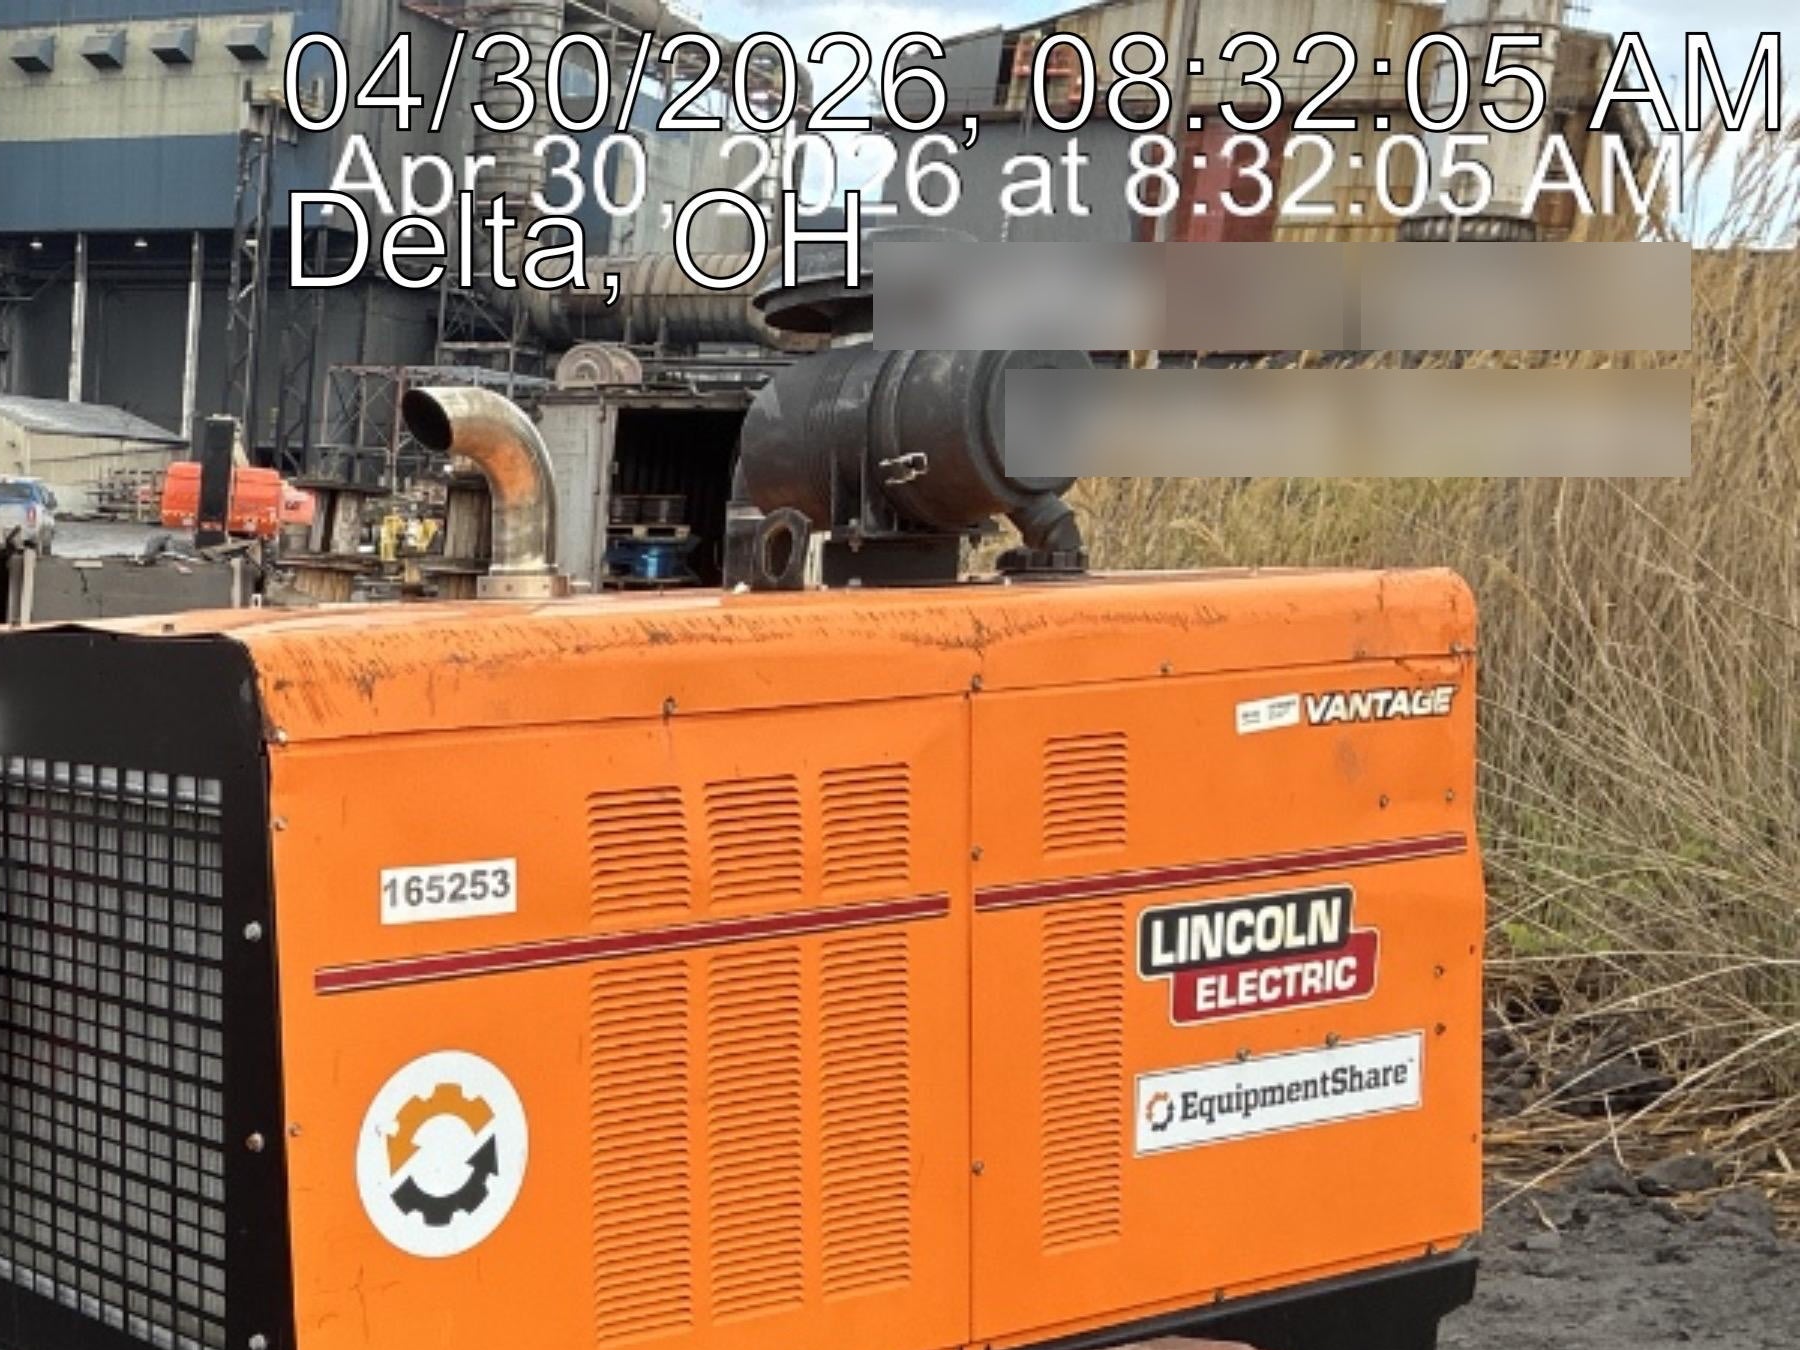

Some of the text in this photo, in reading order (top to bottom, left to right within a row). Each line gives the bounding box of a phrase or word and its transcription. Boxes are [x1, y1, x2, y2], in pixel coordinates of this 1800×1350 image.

[1304, 684, 1457, 725] VANTAGE
[383, 867, 511, 908] 165253
[1150, 896, 1343, 967] LINCOLN
[1195, 955, 1358, 1013] ELECTRIC
[1179, 1060, 1408, 1124] EquipmentShare
